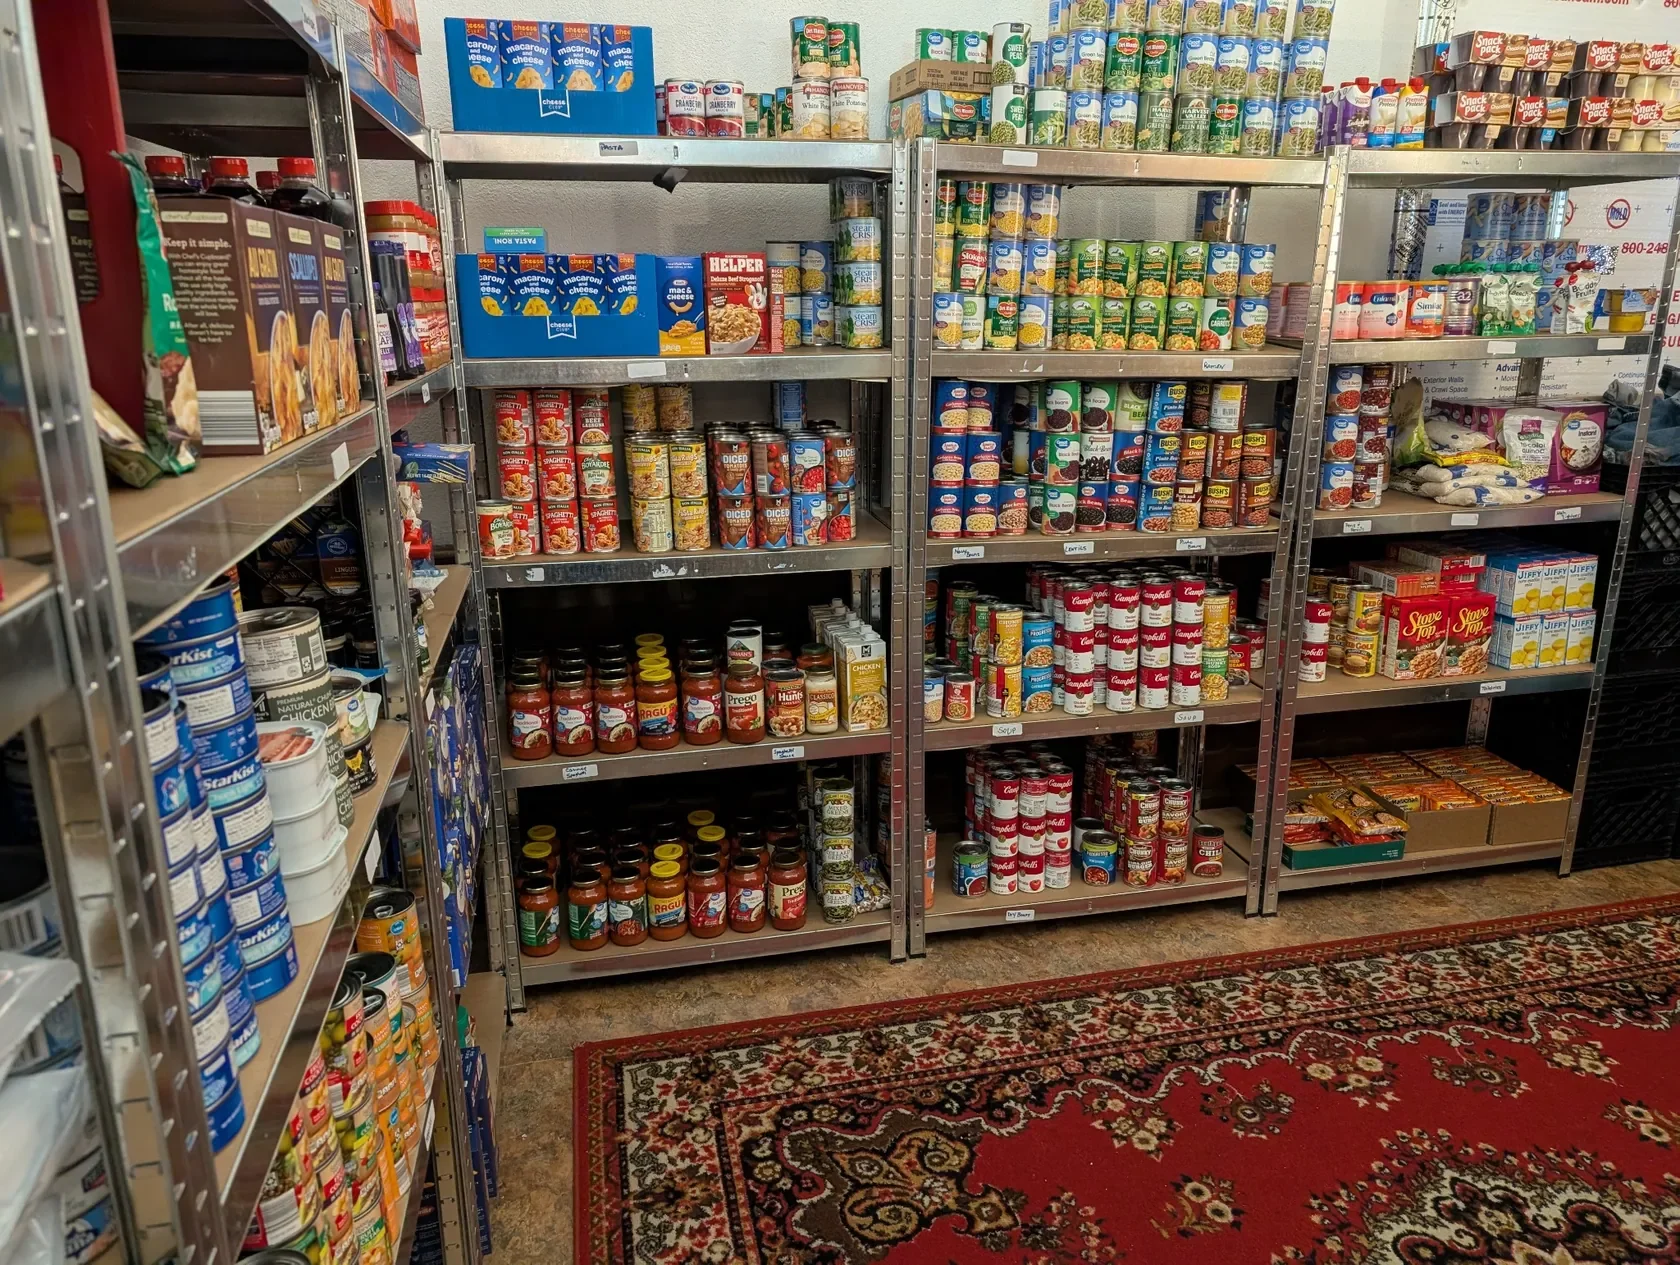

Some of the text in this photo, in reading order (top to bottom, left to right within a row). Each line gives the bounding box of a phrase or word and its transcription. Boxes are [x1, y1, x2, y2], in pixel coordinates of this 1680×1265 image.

[1475, 35, 1503, 49] Snack
[506, 44, 549, 56] macaroni
[558, 46, 599, 57] macaroni
[1008, 44, 1024, 52] SWEET
[1480, 45, 1501, 55] pack
[1592, 43, 1618, 54] Snack
[1009, 51, 1023, 60] PEAS
[1528, 52, 1548, 63] pack
[1595, 52, 1616, 62] pack
[1645, 49, 1673, 60] Snack
[513, 57, 544, 66] cheese
[563, 58, 594, 68] cheese
[1650, 56, 1671, 66] pack
[1460, 95, 1487, 108] Snack
[1518, 101, 1544, 112] Snack
[1583, 101, 1610, 111] Snack
[1010, 105, 1025, 113] SWEET
[1464, 102, 1486, 116] pack
[1523, 108, 1543, 120] pack
[1588, 109, 1608, 119] pack
[1633, 104, 1661, 115] Snack
[1637, 111, 1659, 120] pack
[844, 182, 868, 190] steam
[844, 188, 868, 197] CRISP
[852, 224, 875, 233] steam
[852, 231, 875, 239] CRISP
[198, 238, 232, 250] simple.
[710, 257, 763, 272] HELPER
[854, 269, 877, 277] steam
[514, 275, 555, 286] macaroni
[563, 275, 603, 286] macaroni
[854, 275, 877, 283] CRISP
[519, 286, 550, 295] cheese
[569, 286, 598, 295] cheese
[1457, 291, 1471, 301] a2
[854, 313, 877, 321] steam
[854, 319, 877, 327] CRISP
[1245, 434, 1265, 444] BUSH'S
[544, 457, 571, 465] SPAGHETTI
[723, 454, 748, 464] DICED
[1208, 486, 1229, 495] BUSH'S
[545, 511, 574, 519] SPAGHETTI
[726, 510, 750, 518] DICED
[766, 510, 790, 518] DICED
[1544, 568, 1567, 576] JIFFY
[1570, 565, 1596, 573] JIFFY
[1518, 571, 1541, 579] JIFFY
[1403, 610, 1442, 636] Stove
[1452, 607, 1489, 633] Stove
[1572, 619, 1594, 628] JIFFY
[1465, 622, 1483, 637] Top
[1516, 623, 1539, 632] JIFFY
[1544, 621, 1567, 630] JIFFY
[1416, 625, 1436, 641] Top
[852, 663, 881, 672] CHICKEN
[276, 696, 304, 705] PREMIUM
[727, 694, 757, 705] Prego
[278, 700, 313, 714] NATURAL
[640, 704, 667, 720] RAGÚ
[203, 762, 256, 791] StarKist
